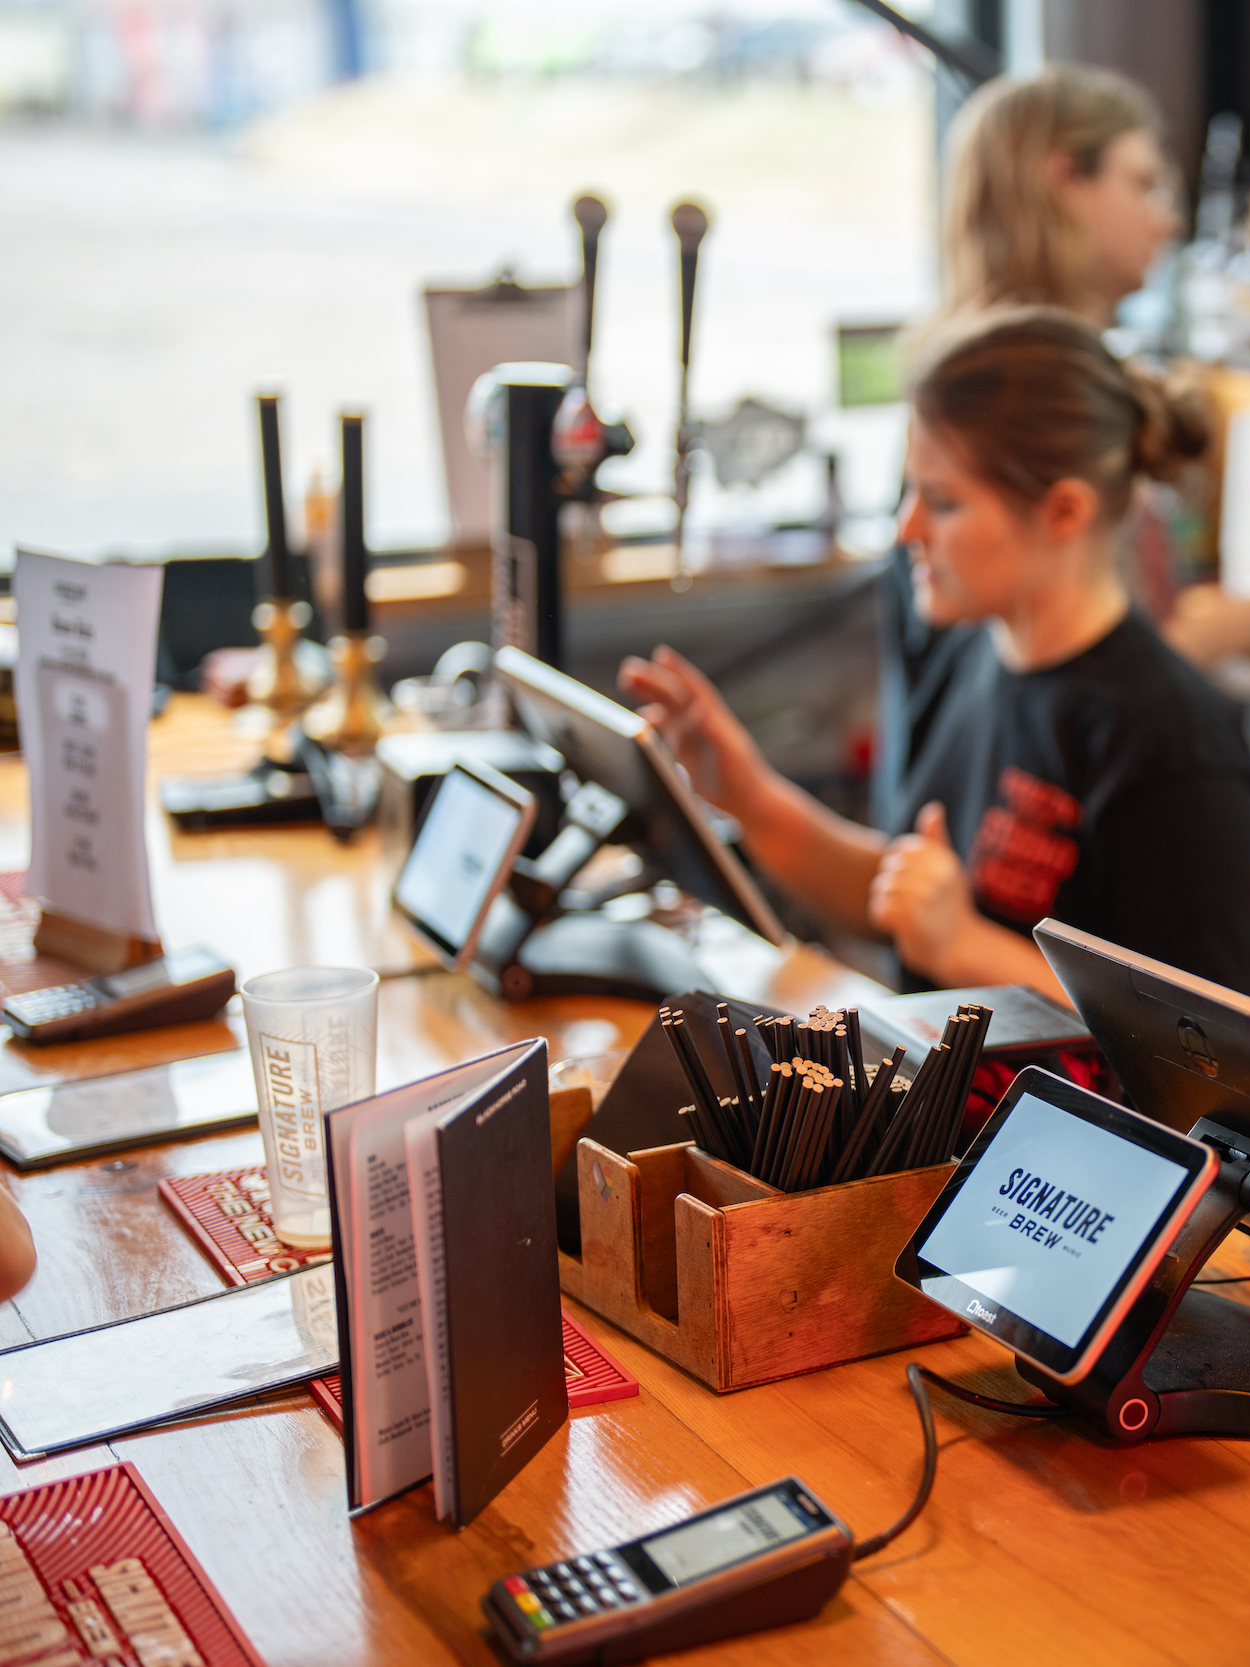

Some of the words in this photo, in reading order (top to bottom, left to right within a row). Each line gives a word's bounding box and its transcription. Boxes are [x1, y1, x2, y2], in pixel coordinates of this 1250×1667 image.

[266, 1045, 304, 1183] SIGNATURE
[300, 1088, 317, 1150] BREW
[991, 1205, 1009, 1218] BEER
[1008, 1212, 1063, 1249] BREW
[999, 1167, 1116, 1245] SIGNATURE
[974, 1304, 997, 1325] toast
